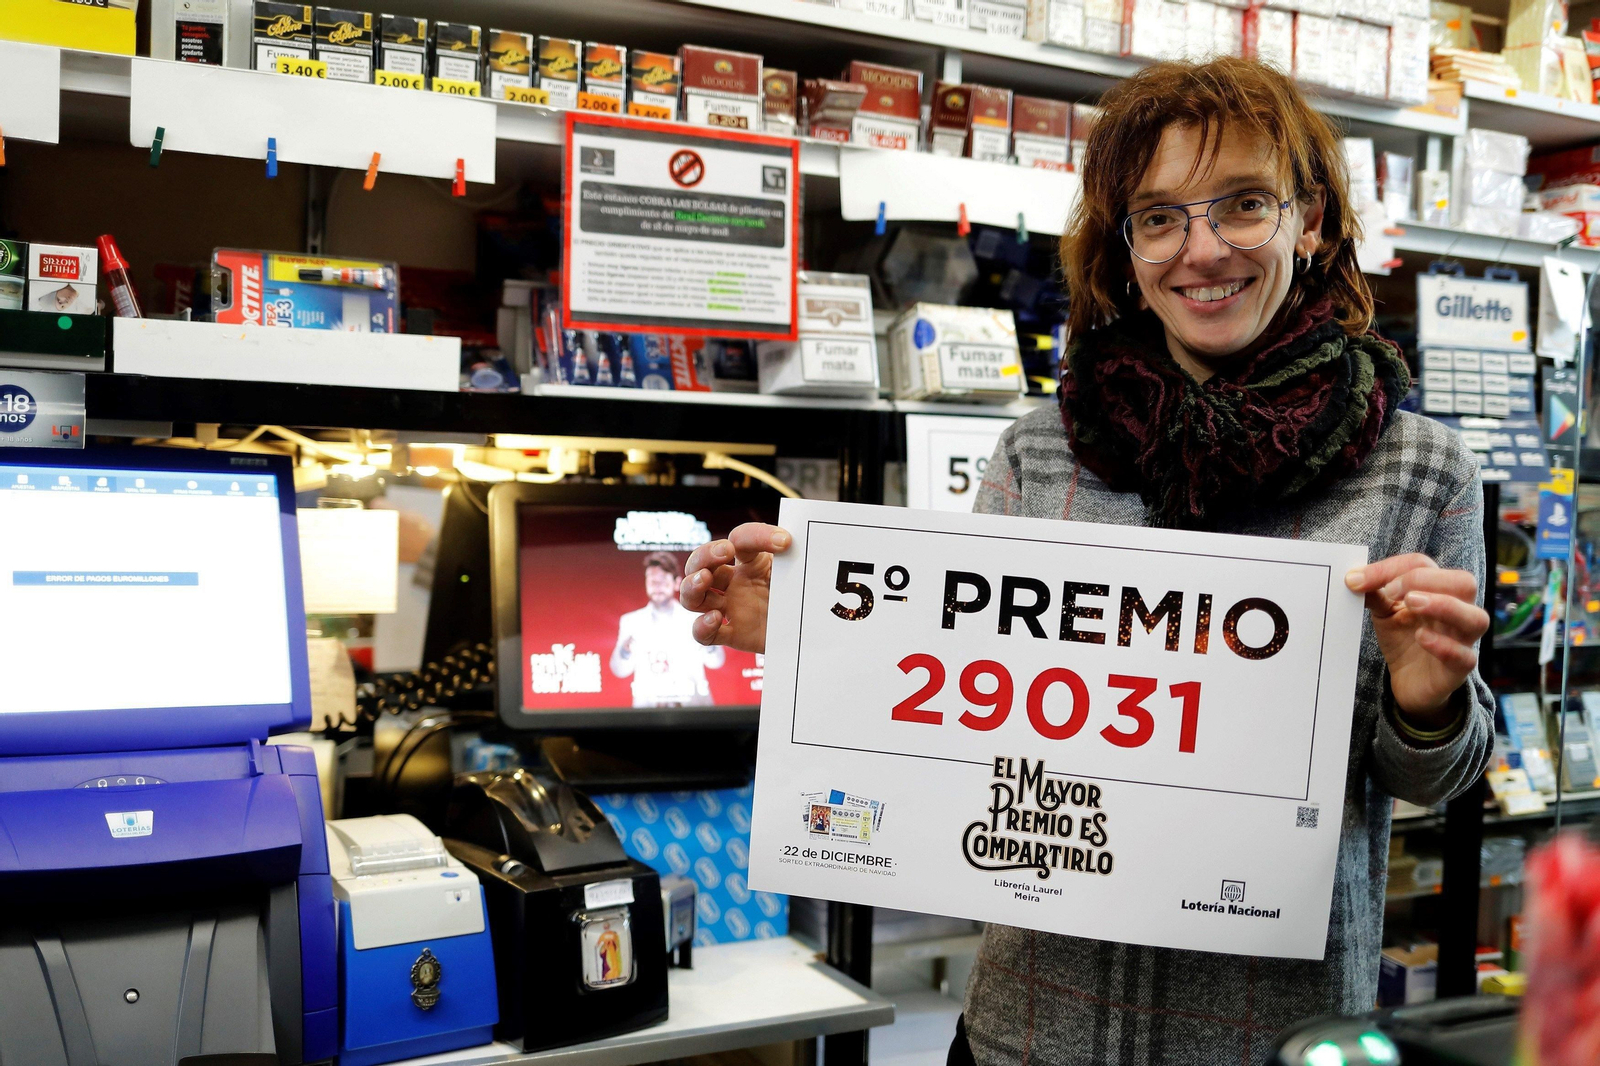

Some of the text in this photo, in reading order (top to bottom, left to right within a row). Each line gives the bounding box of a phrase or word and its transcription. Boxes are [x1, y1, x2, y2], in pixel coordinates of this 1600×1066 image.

[266, 22, 302, 37] Capone
[328, 29, 363, 43] Capone
[181, 43, 204, 51] podemos
[267, 49, 300, 59] Fumar
[281, 63, 313, 77] 3.40
[316, 68, 326, 79] €
[379, 76, 421, 90] 2.00 €
[701, 76, 745, 90] MOODS
[469, 88, 477, 97] €
[581, 99, 620, 113] 2.00 €
[703, 100, 741, 113] Fumar
[41, 256, 77, 267] MORRIS
[42, 263, 77, 275] PHILIP
[266, 303, 277, 327] PER
[1435, 294, 1514, 322] Gillette
[815, 342, 859, 357] Fumar
[949, 347, 1004, 364] Fumar
[821, 359, 856, 373] mata
[958, 363, 1001, 380] mata
[0, 393, 30, 413] 18
[86, 575, 112, 583] PAGOS
[112, 575, 170, 583] EUROMILLONES
[829, 559, 1290, 661] 5º PREMIO
[891, 652, 1203, 755] 29031
[993, 757, 1016, 779] EL
[988, 783, 1073, 837] PREMIO
[112, 825, 152, 834] LOTERÍAS
[802, 848, 818, 859] de
[962, 821, 1114, 880] COMPARTIRLO
[778, 857, 803, 866] SORTEO
[804, 860, 859, 873] EXTRAORDINARIO
[869, 868, 897, 877] NAVIDAD
[994, 878, 1063, 896] Librería Laurel
[1014, 892, 1041, 903] Meira
[1181, 899, 1281, 919] Lotería Nacional
